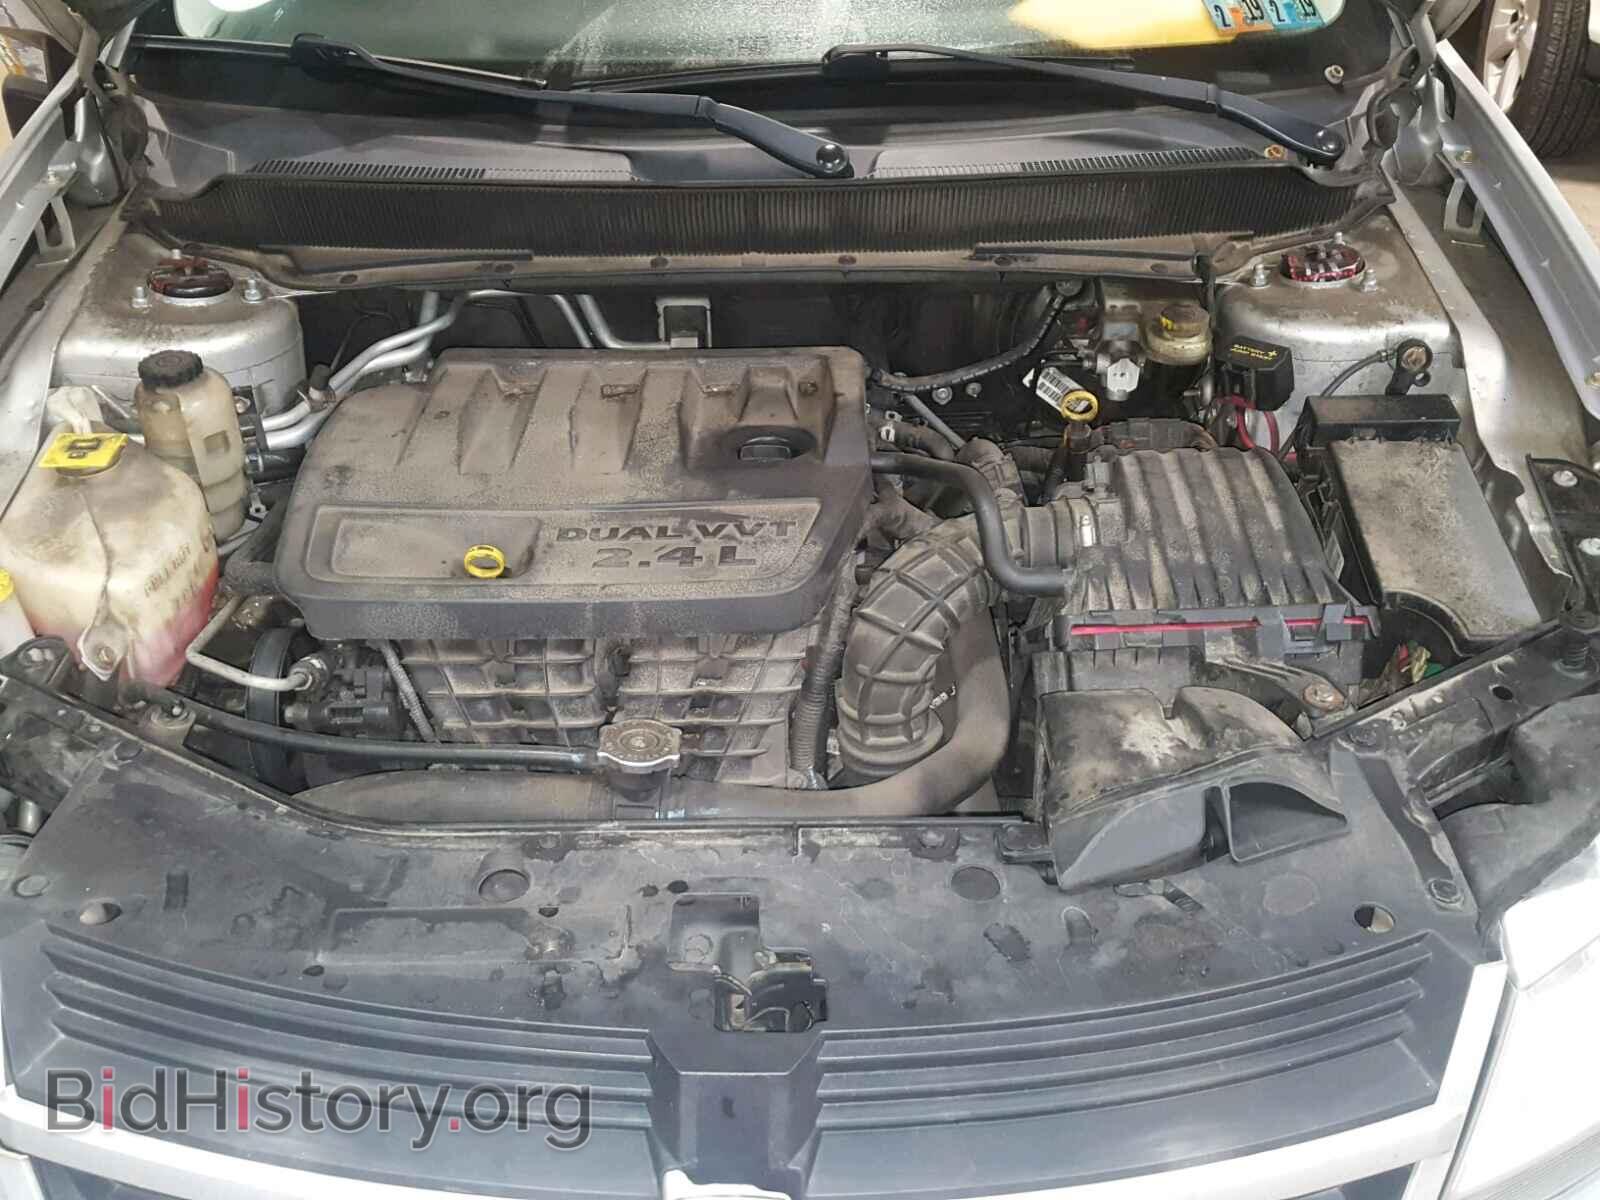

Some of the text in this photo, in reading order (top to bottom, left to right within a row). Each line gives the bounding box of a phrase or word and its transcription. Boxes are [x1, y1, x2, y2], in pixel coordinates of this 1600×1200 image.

[1213, 4, 1231, 27] 2
[1241, 0, 1265, 20] 19
[1269, 0, 1286, 22] 2
[556, 520, 797, 541] DUAL VVT
[592, 545, 757, 568] 2.4L
